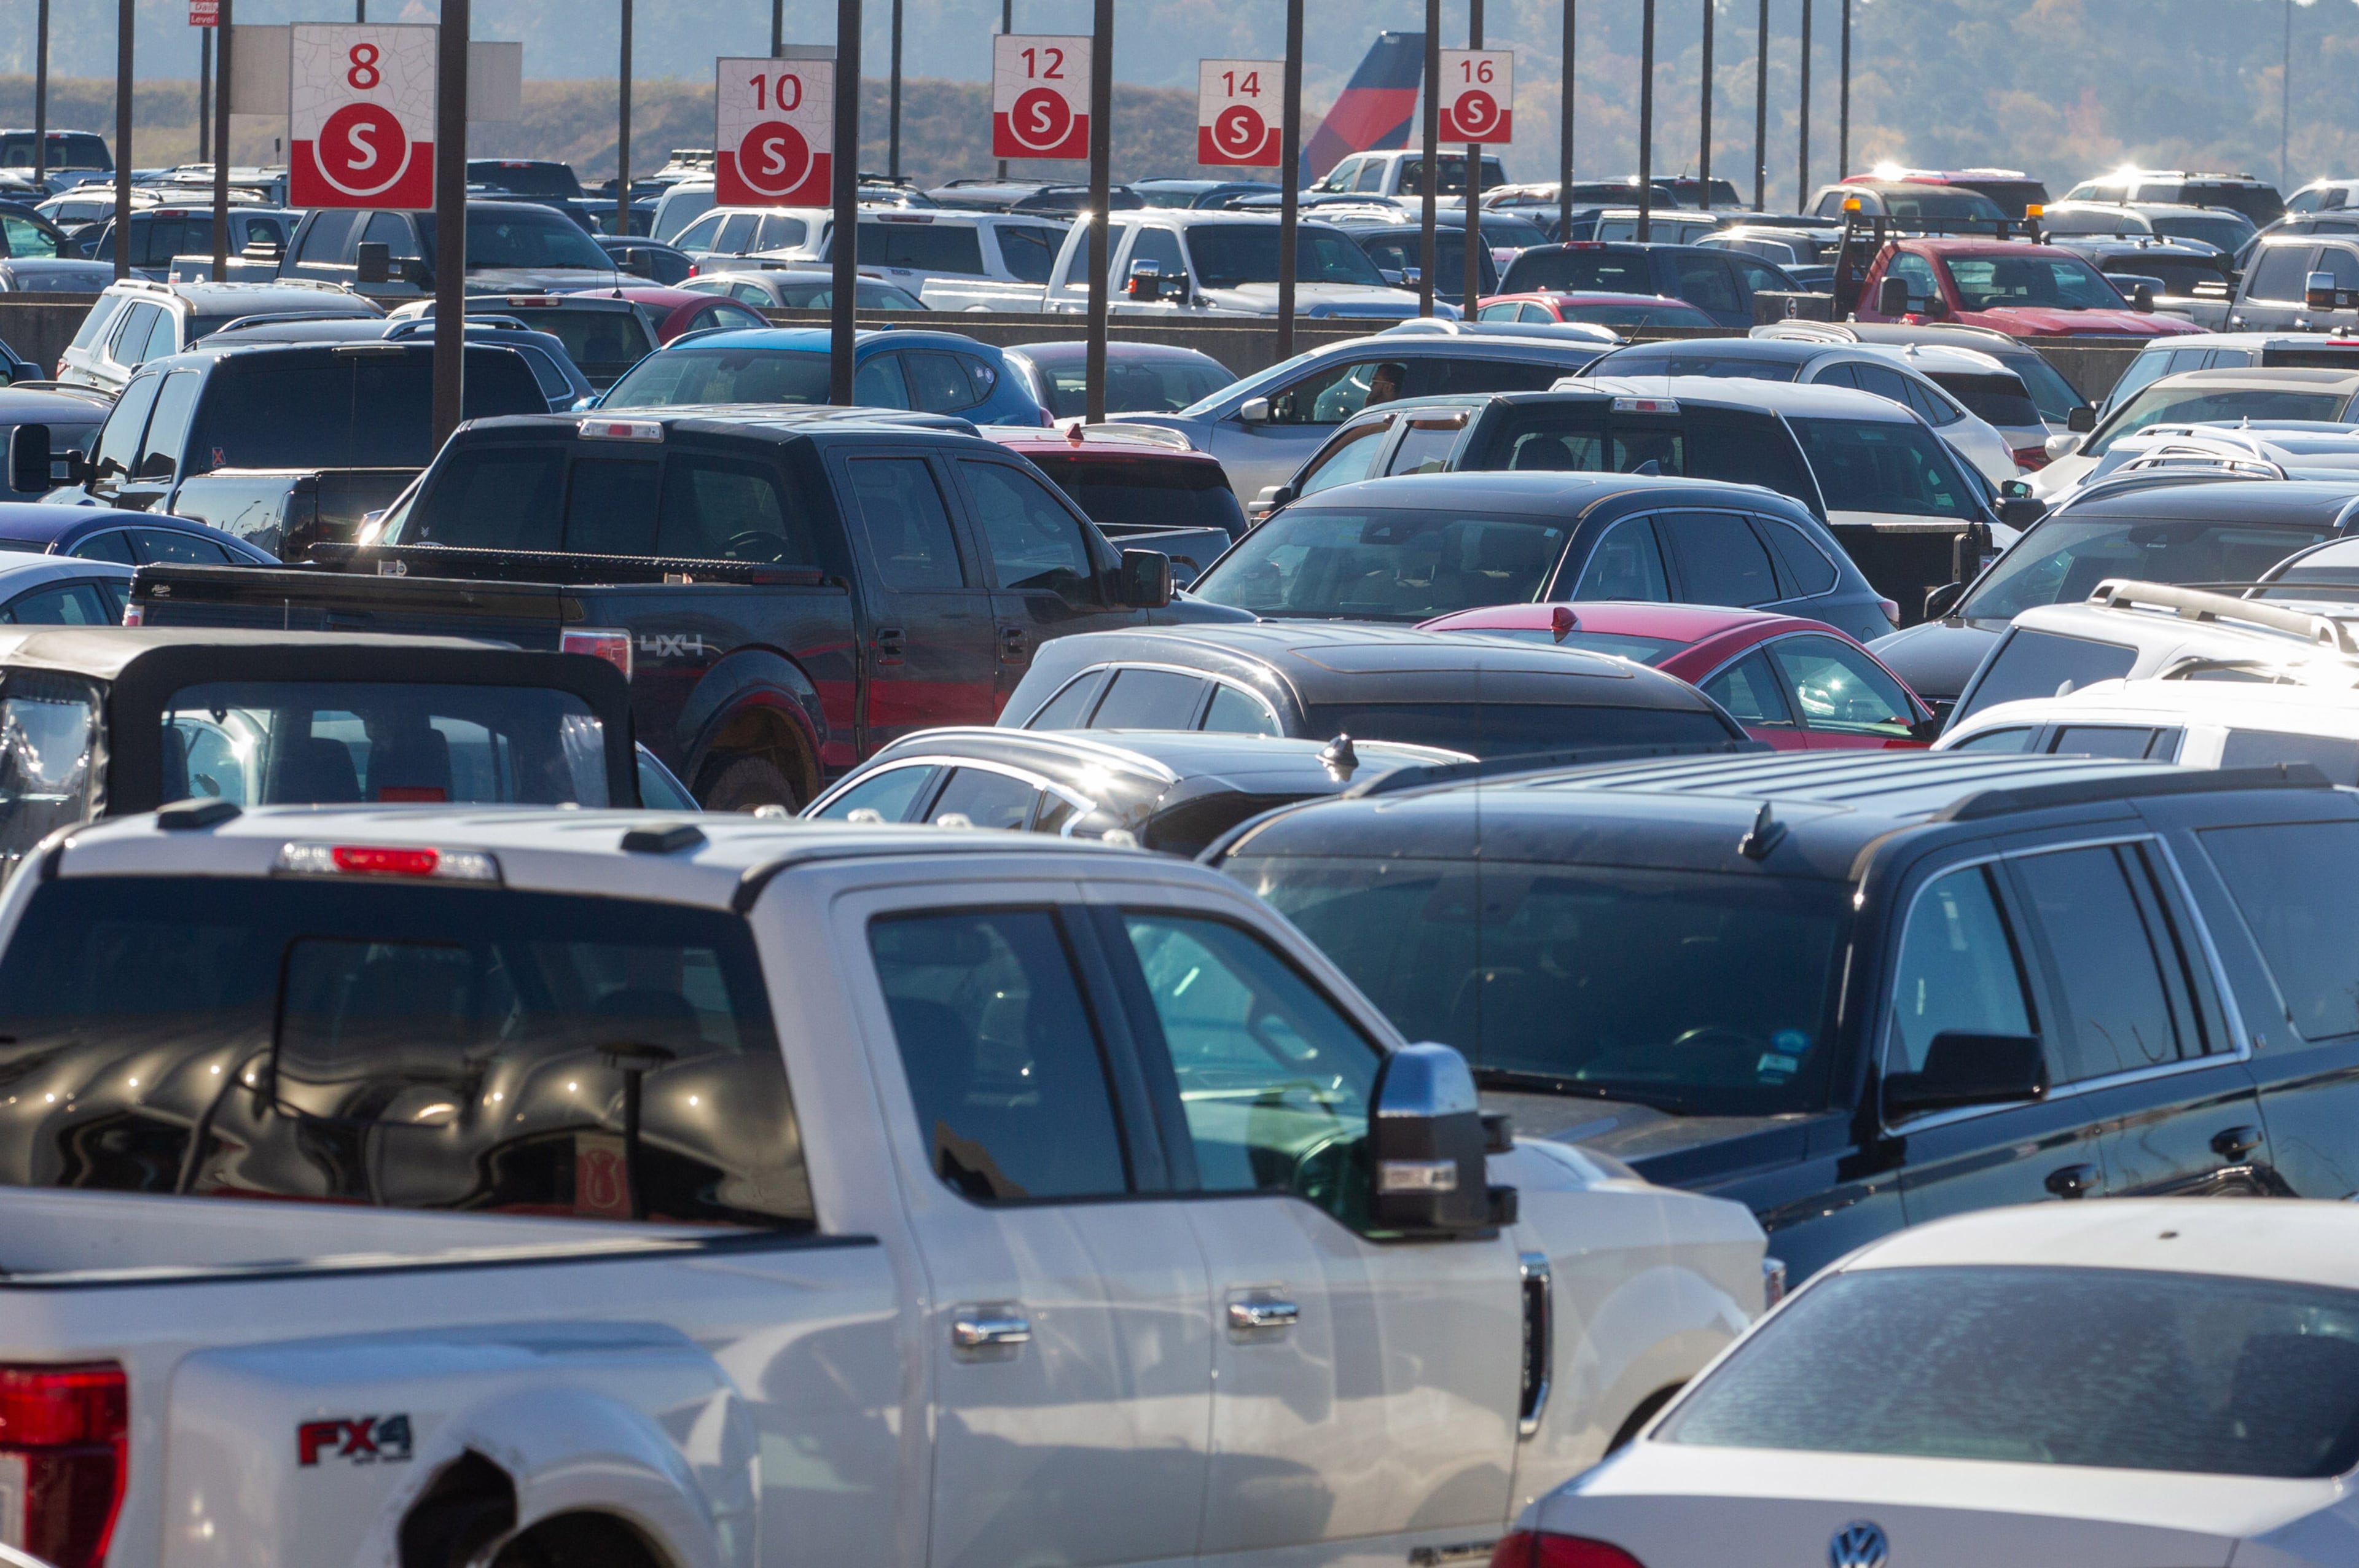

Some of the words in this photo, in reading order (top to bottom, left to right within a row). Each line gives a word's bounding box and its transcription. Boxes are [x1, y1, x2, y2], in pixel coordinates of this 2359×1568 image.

[191, 15, 215, 23] Level
[347, 43, 380, 90] 8
[1021, 48, 1064, 79] 12
[1460, 60, 1493, 84] 16
[749, 74, 802, 111] 10
[1222, 71, 1261, 97] 14
[1031, 101, 1051, 133] S
[1467, 99, 1484, 123] S
[1230, 116, 1249, 144] S
[347, 122, 377, 170] S
[762, 137, 786, 175] S
[640, 634, 703, 657] 4X4
[299, 1414, 412, 1466] FX4
